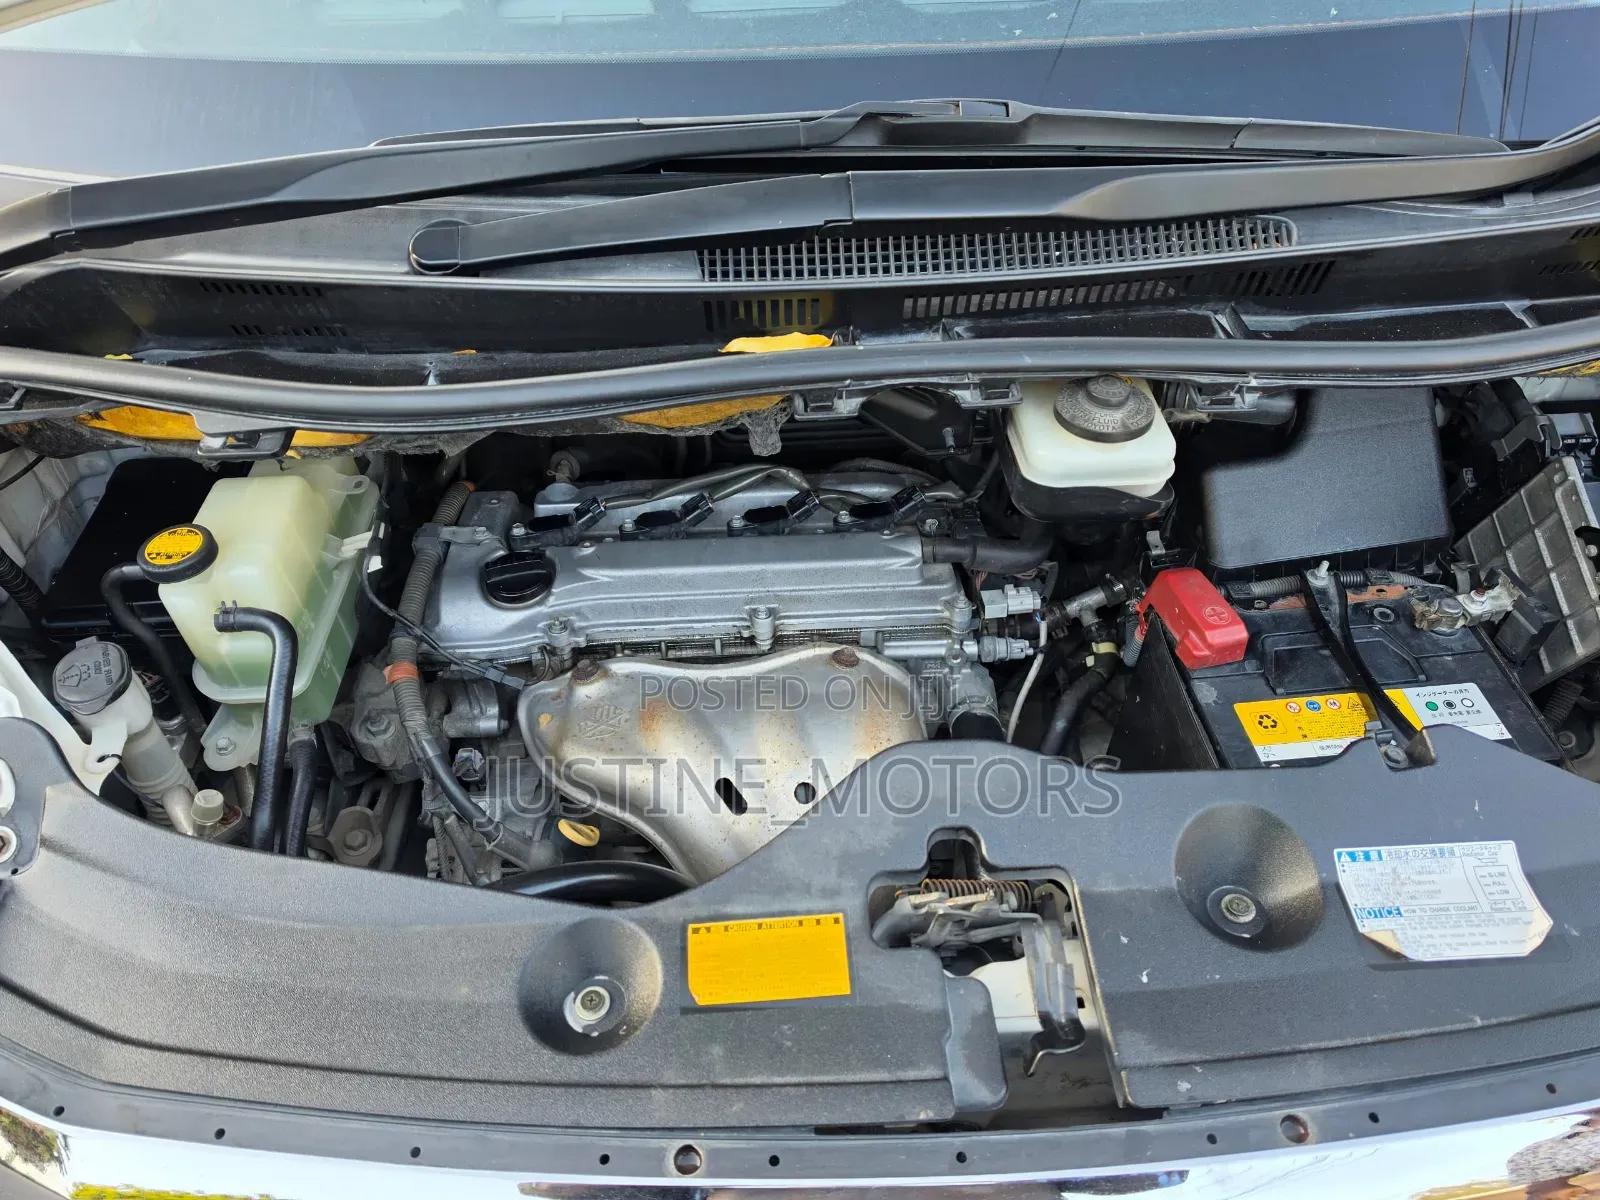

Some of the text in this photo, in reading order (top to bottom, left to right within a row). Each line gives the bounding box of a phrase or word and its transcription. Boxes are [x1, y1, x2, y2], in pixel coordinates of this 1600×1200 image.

[1082, 420, 1117, 431] TOYOTA
[1091, 416, 1119, 425] FLUID
[1356, 906, 1400, 920] NOTICE
